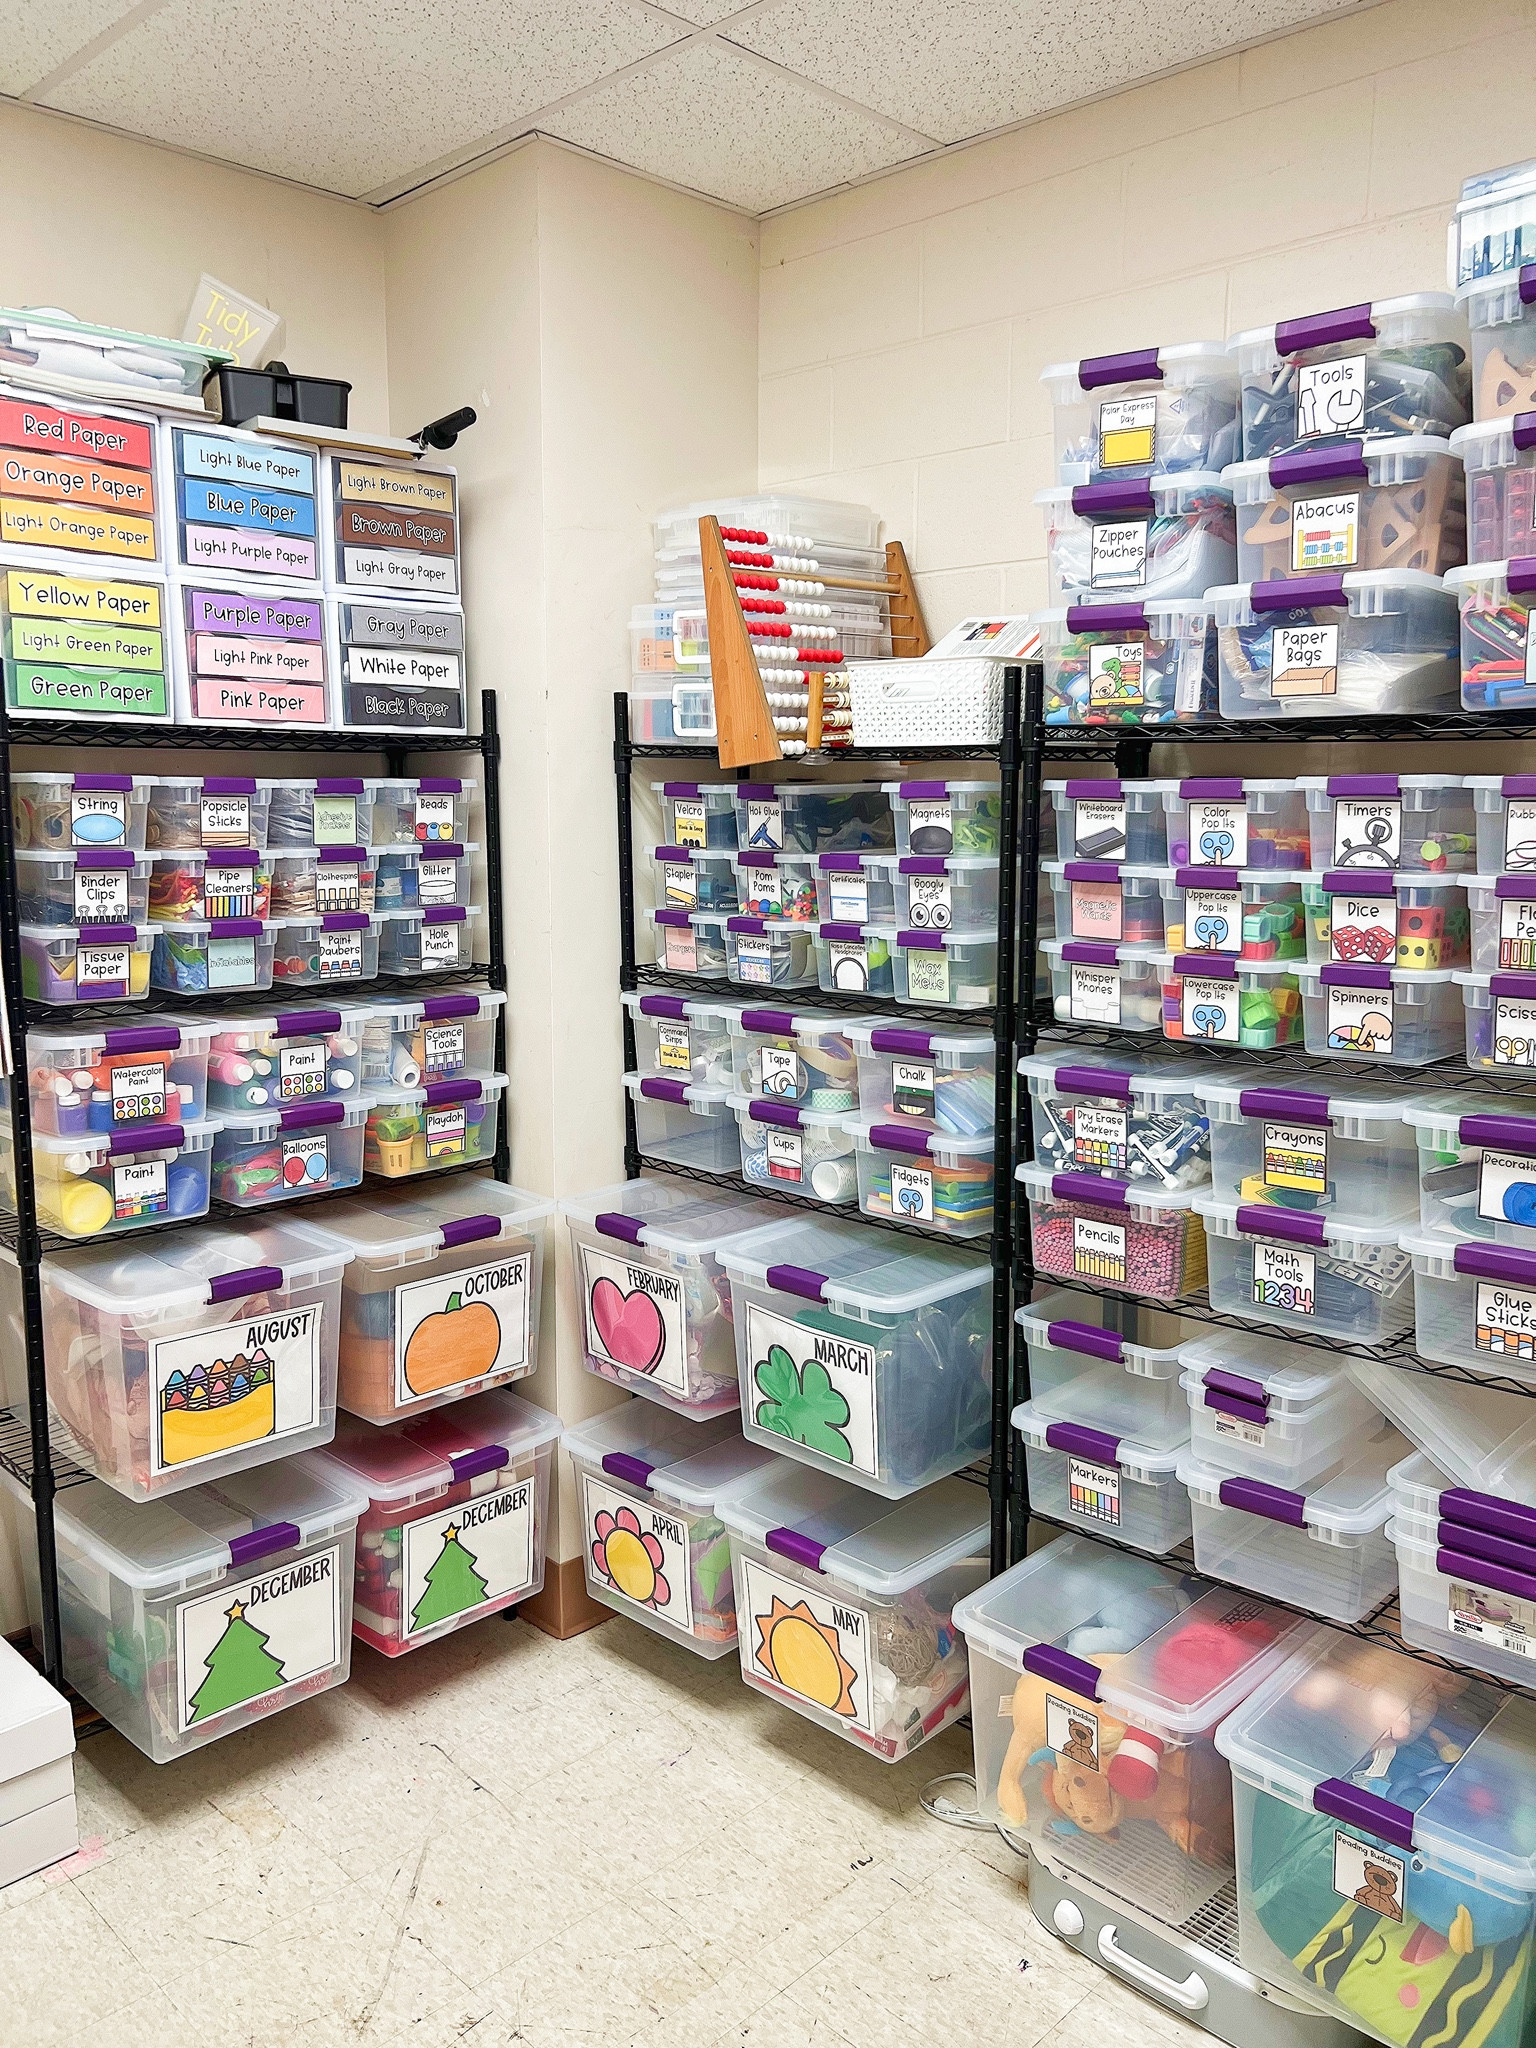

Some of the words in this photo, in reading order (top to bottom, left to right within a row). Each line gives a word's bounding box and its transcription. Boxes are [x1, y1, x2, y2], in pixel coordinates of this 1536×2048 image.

[205, 290, 261, 348] Tidy
[1310, 365, 1354, 387] Tools
[1102, 406, 1120, 415] Polar
[1123, 401, 1154, 414] Express
[1120, 415, 1135, 425] Day
[24, 414, 64, 439] Red
[71, 422, 127, 451] Paper
[199, 449, 232, 468] Light
[236, 455, 262, 472] Blue
[266, 460, 300, 479] Paper
[6, 461, 84, 493] Orange
[92, 473, 146, 501] Paper
[347, 475, 376, 491] Light
[380, 478, 415, 494] Brown
[418, 484, 446, 501] Paper
[207, 491, 245, 514] Blue
[250, 498, 297, 525] Paper
[1296, 502, 1355, 520] Abacus
[5, 512, 43, 532] Light
[50, 517, 105, 541] Orange
[110, 526, 149, 545] Paper
[352, 513, 402, 537] Brown
[405, 520, 447, 545] Paper
[1100, 530, 1139, 545] Zipper
[194, 538, 226, 556] Light
[232, 542, 272, 562] Purple
[276, 548, 309, 567] Paper
[1093, 545, 1144, 559] Pouches
[356, 560, 384, 576] Light
[388, 562, 415, 580] Gray
[418, 566, 446, 582] Paper
[19, 582, 90, 607] Yellow
[97, 591, 150, 616] Paper
[203, 602, 261, 627] Purple
[266, 607, 312, 632] Paper
[367, 616, 405, 639] Gray
[409, 618, 450, 642] Paper
[22, 631, 60, 651] Light
[66, 636, 111, 652] Green
[115, 640, 153, 659] Paper
[1282, 631, 1328, 650] Paper
[214, 649, 246, 667] Light
[250, 651, 273, 665] Pink
[277, 654, 310, 671] Paper
[1116, 646, 1142, 660] Toys
[1287, 647, 1321, 666] Bags
[360, 657, 406, 675] White
[411, 660, 449, 681] Paper
[31, 676, 93, 697] Green
[100, 681, 153, 706] Paper
[220, 690, 253, 708] Pink
[259, 692, 305, 715] Paper
[365, 696, 405, 715] Black
[408, 698, 449, 721] Paper
[77, 797, 118, 813] String
[202, 800, 247, 814] Popsicle
[420, 798, 448, 810] Beads
[677, 804, 702, 816] Velcro
[749, 805, 762, 816] Hot
[763, 806, 780, 817] Glue
[1079, 803, 1123, 812] Whiteboard
[1344, 803, 1392, 816] Timers
[910, 808, 951, 822] Magnets
[1086, 812, 1115, 821] Erasers
[1203, 806, 1230, 818] Color
[1509, 809, 1536, 819] Rubb
[208, 815, 242, 827] Sticks
[1201, 818, 1220, 830] Pop
[1222, 818, 1236, 829] Its
[218, 870, 240, 883] Pipe
[317, 872, 358, 881] Clothespins
[422, 865, 452, 876] Glitter
[666, 868, 694, 881] Stapler
[755, 870, 773, 881] Pom
[81, 875, 120, 887] Binder
[753, 880, 775, 893] Poms
[831, 875, 866, 884] Certificates
[914, 877, 944, 892] Googly
[206, 882, 252, 894] Cleaners
[1186, 889, 1237, 901] Uppercase
[87, 889, 115, 904] Clips
[918, 890, 940, 903] Eyes
[1076, 898, 1117, 912] Magnetic
[1198, 903, 1214, 914] Pop
[1216, 903, 1228, 913] Its
[1347, 901, 1379, 918] Dice
[1081, 909, 1112, 921] Wands
[328, 935, 351, 945] Paint
[430, 929, 449, 939] Hole
[319, 946, 360, 956] Daubers
[425, 939, 454, 950] Punch
[738, 938, 770, 951] Stickers
[81, 950, 124, 963] Tissue
[84, 963, 121, 978] Paper
[914, 960, 942, 975] Wax
[912, 974, 945, 991] Melts
[1075, 970, 1116, 984] Whisper
[1077, 983, 1113, 995] Phones
[1184, 979, 1235, 991] Lowercase
[1195, 990, 1211, 1000] Pop
[1213, 991, 1225, 1000] Its
[1331, 990, 1389, 1006] Spinners
[426, 1028, 463, 1040] Science
[659, 1026, 688, 1037] Command
[432, 1038, 457, 1050] Tools
[665, 1034, 683, 1045] Strips
[289, 1054, 315, 1066] Paint
[768, 1052, 791, 1068] Tape
[113, 1066, 163, 1080] Watercolor
[899, 1067, 926, 1081] Chalk
[128, 1077, 149, 1086] Paint
[428, 1112, 463, 1128] Playdoh
[1077, 1109, 1093, 1124] Dry
[1096, 1113, 1123, 1125] Erase
[1081, 1123, 1119, 1138] Markers
[1265, 1126, 1324, 1147] Crayons
[283, 1139, 326, 1156] Balloons
[773, 1136, 795, 1152] Cups
[124, 1168, 155, 1180] Paint
[1063, 1162, 1085, 1172] EXPO
[892, 1168, 929, 1186] Fidgets
[1078, 1224, 1121, 1244] Pencils
[1264, 1248, 1299, 1267] Math
[1265, 1263, 1304, 1282] Tools
[464, 1263, 523, 1298] OCTOBER
[627, 1267, 679, 1303] FEBRUARY
[1255, 1279, 1314, 1313] 1234
[1494, 1291, 1532, 1312] Glue
[1486, 1306, 1536, 1330] Sticks
[246, 1313, 312, 1349] AUGUST
[813, 1338, 869, 1376] MARCH
[1070, 1462, 1117, 1488] Markers
[461, 1488, 528, 1531] DECEMBER
[651, 1514, 683, 1546] APRIL
[250, 1557, 331, 1606] DECEMBER
[832, 1605, 861, 1637] MAY
[1047, 1696, 1072, 1715] Reading
[1072, 1709, 1096, 1725] Buddies
[1337, 1834, 1368, 1856] Reading
[1370, 1851, 1402, 1870] Buddies
